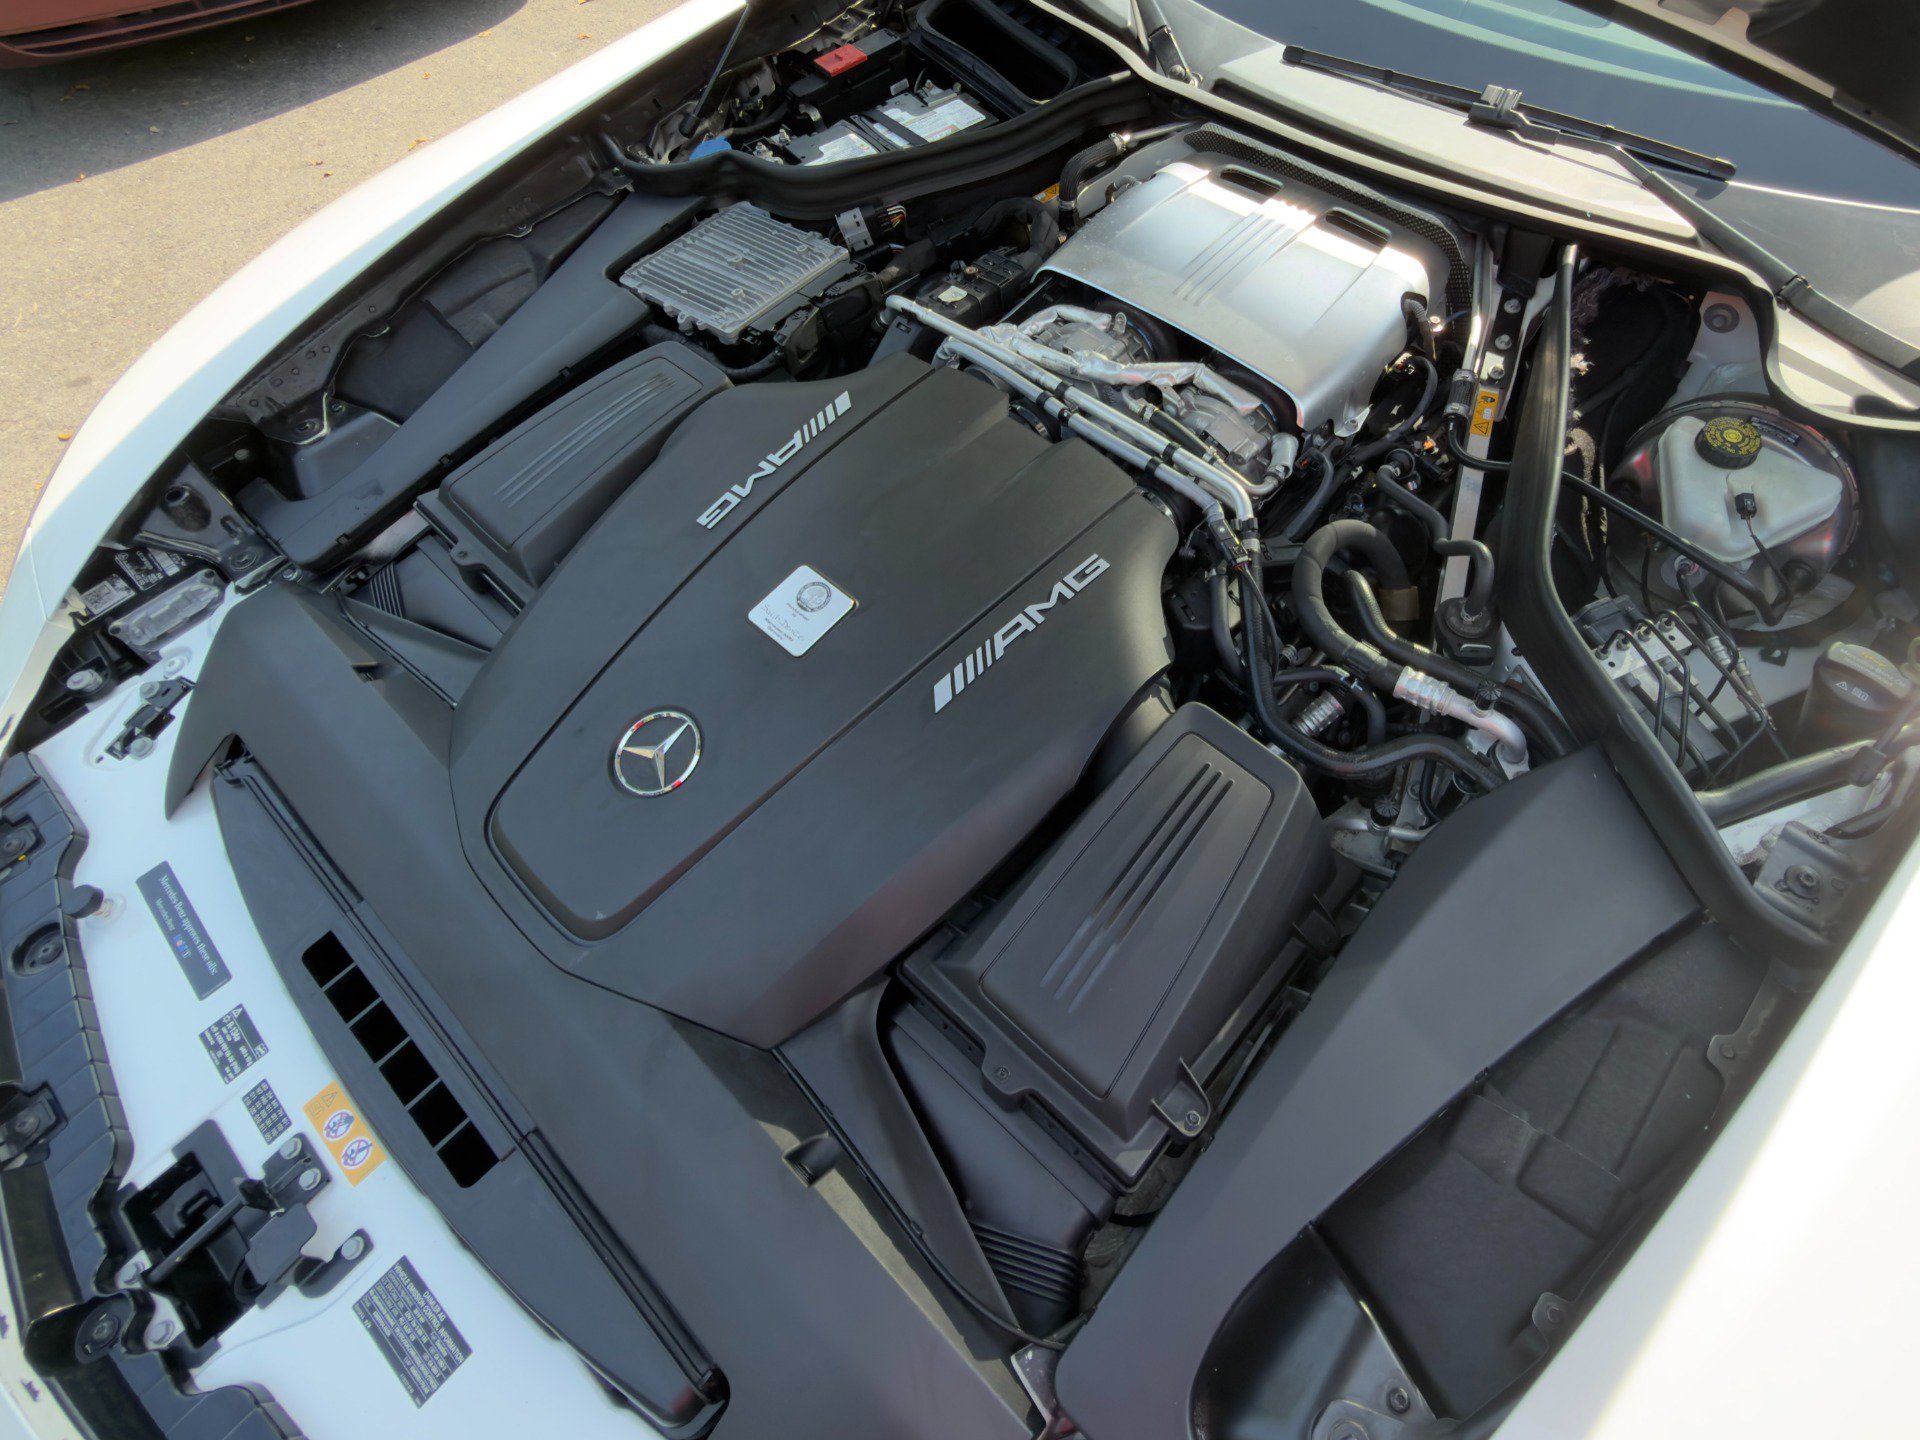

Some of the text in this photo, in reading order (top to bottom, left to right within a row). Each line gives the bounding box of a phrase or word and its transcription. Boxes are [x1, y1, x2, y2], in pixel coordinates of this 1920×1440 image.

[696, 429, 803, 529] AMG
[994, 552, 1111, 660] AMG
[179, 916, 201, 947] approves
[196, 941, 212, 962] these
[393, 1263, 410, 1285] VEHICLE
[406, 1281, 425, 1308] EMISSION
[421, 1303, 441, 1330] CONTROL
[437, 1326, 465, 1364] INFORMATION
[422, 1290, 446, 1322] DAIMLER AG
